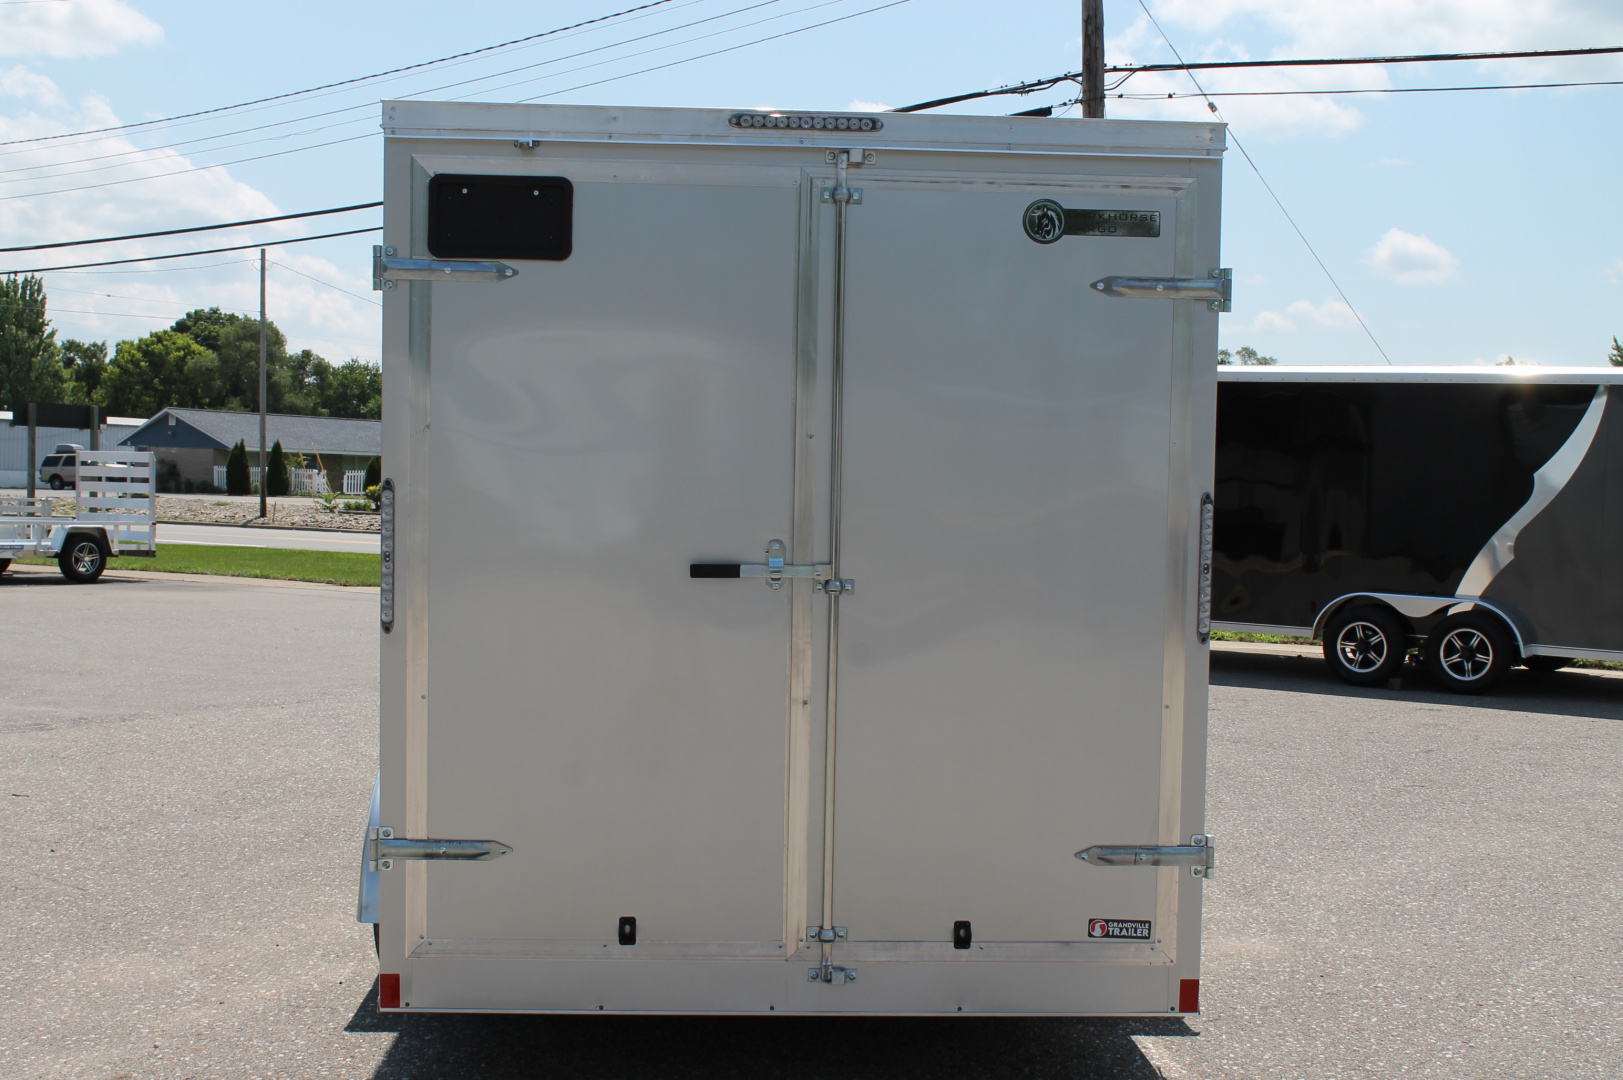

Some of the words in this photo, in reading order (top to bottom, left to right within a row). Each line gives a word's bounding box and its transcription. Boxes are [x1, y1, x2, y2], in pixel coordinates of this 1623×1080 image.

[1069, 212, 1158, 222] RKHORSE
[1069, 225, 1118, 233] RGO
[1108, 921, 1150, 929] GRANDVILLE
[1107, 927, 1149, 937] TRAILER
